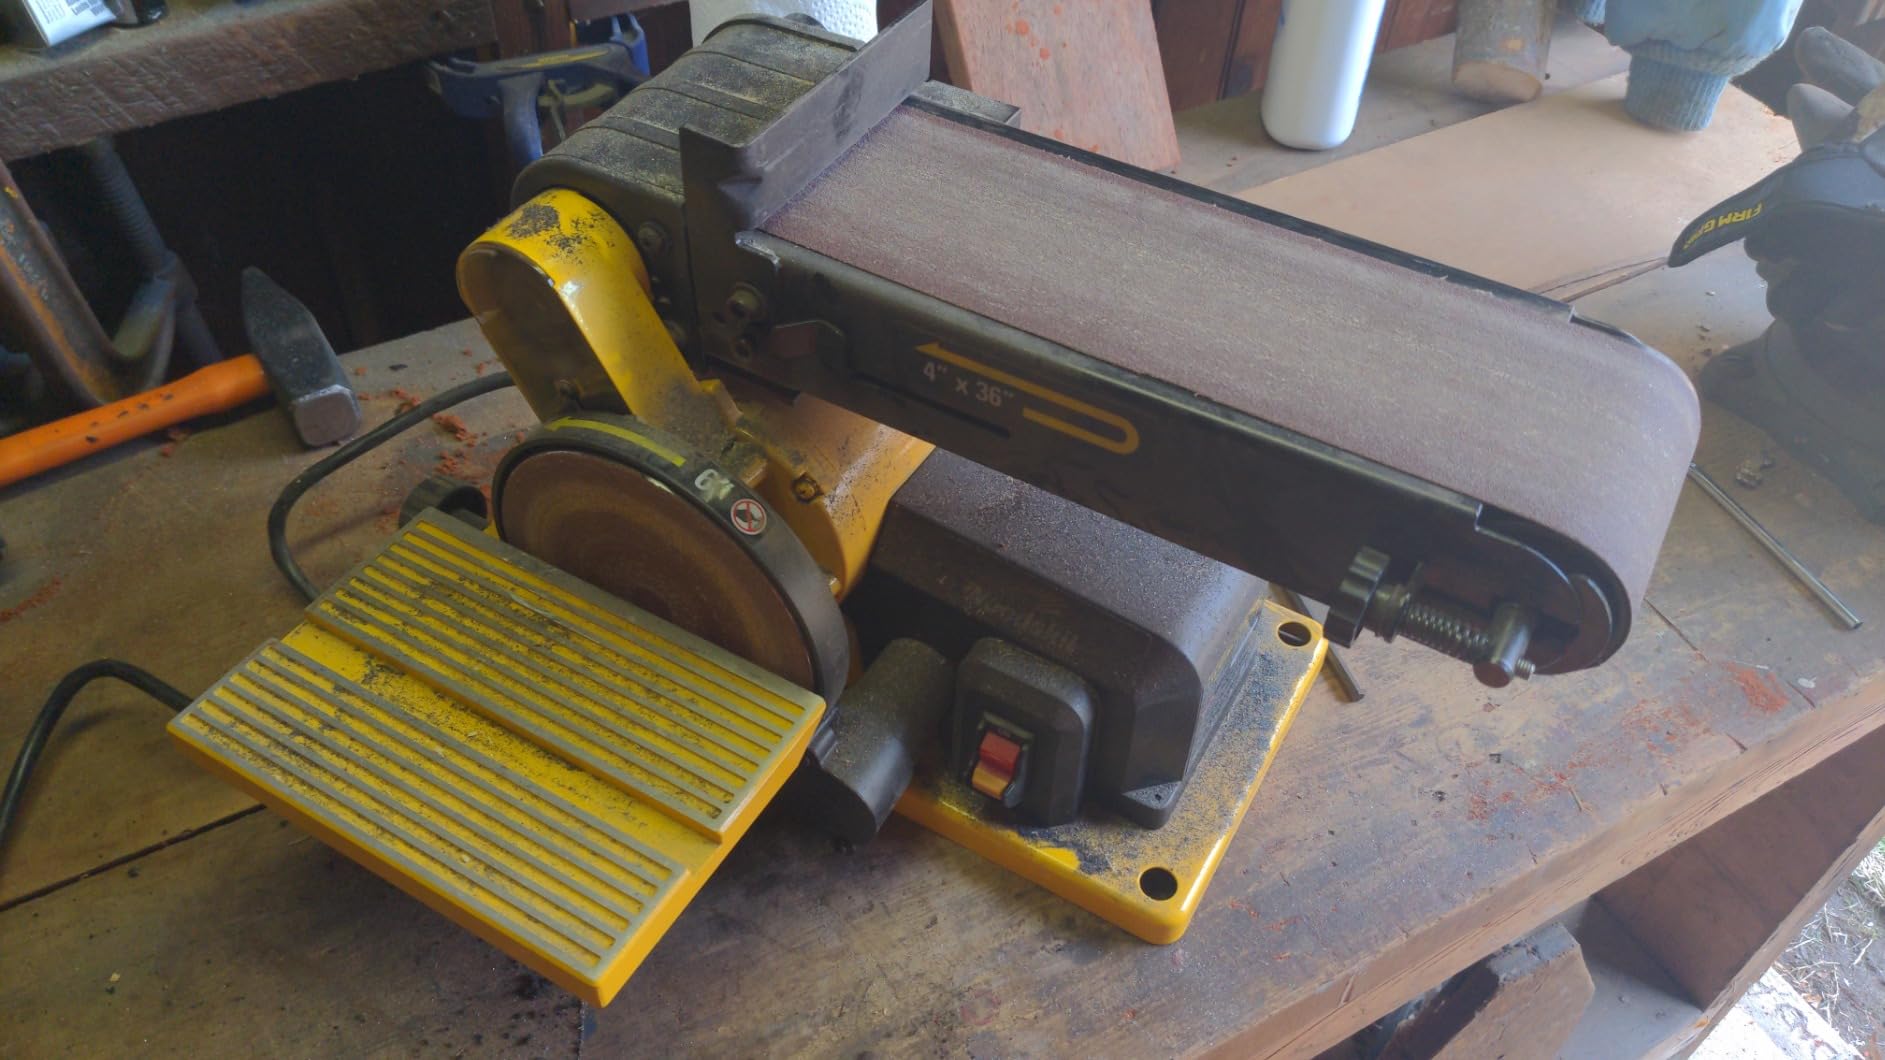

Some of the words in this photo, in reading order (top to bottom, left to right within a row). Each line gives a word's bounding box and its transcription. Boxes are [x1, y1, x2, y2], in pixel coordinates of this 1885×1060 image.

[1718, 202, 1763, 228] FIRM
[923, 362, 947, 381] 4"
[955, 378, 968, 395] x
[976, 382, 1013, 407] 36"
